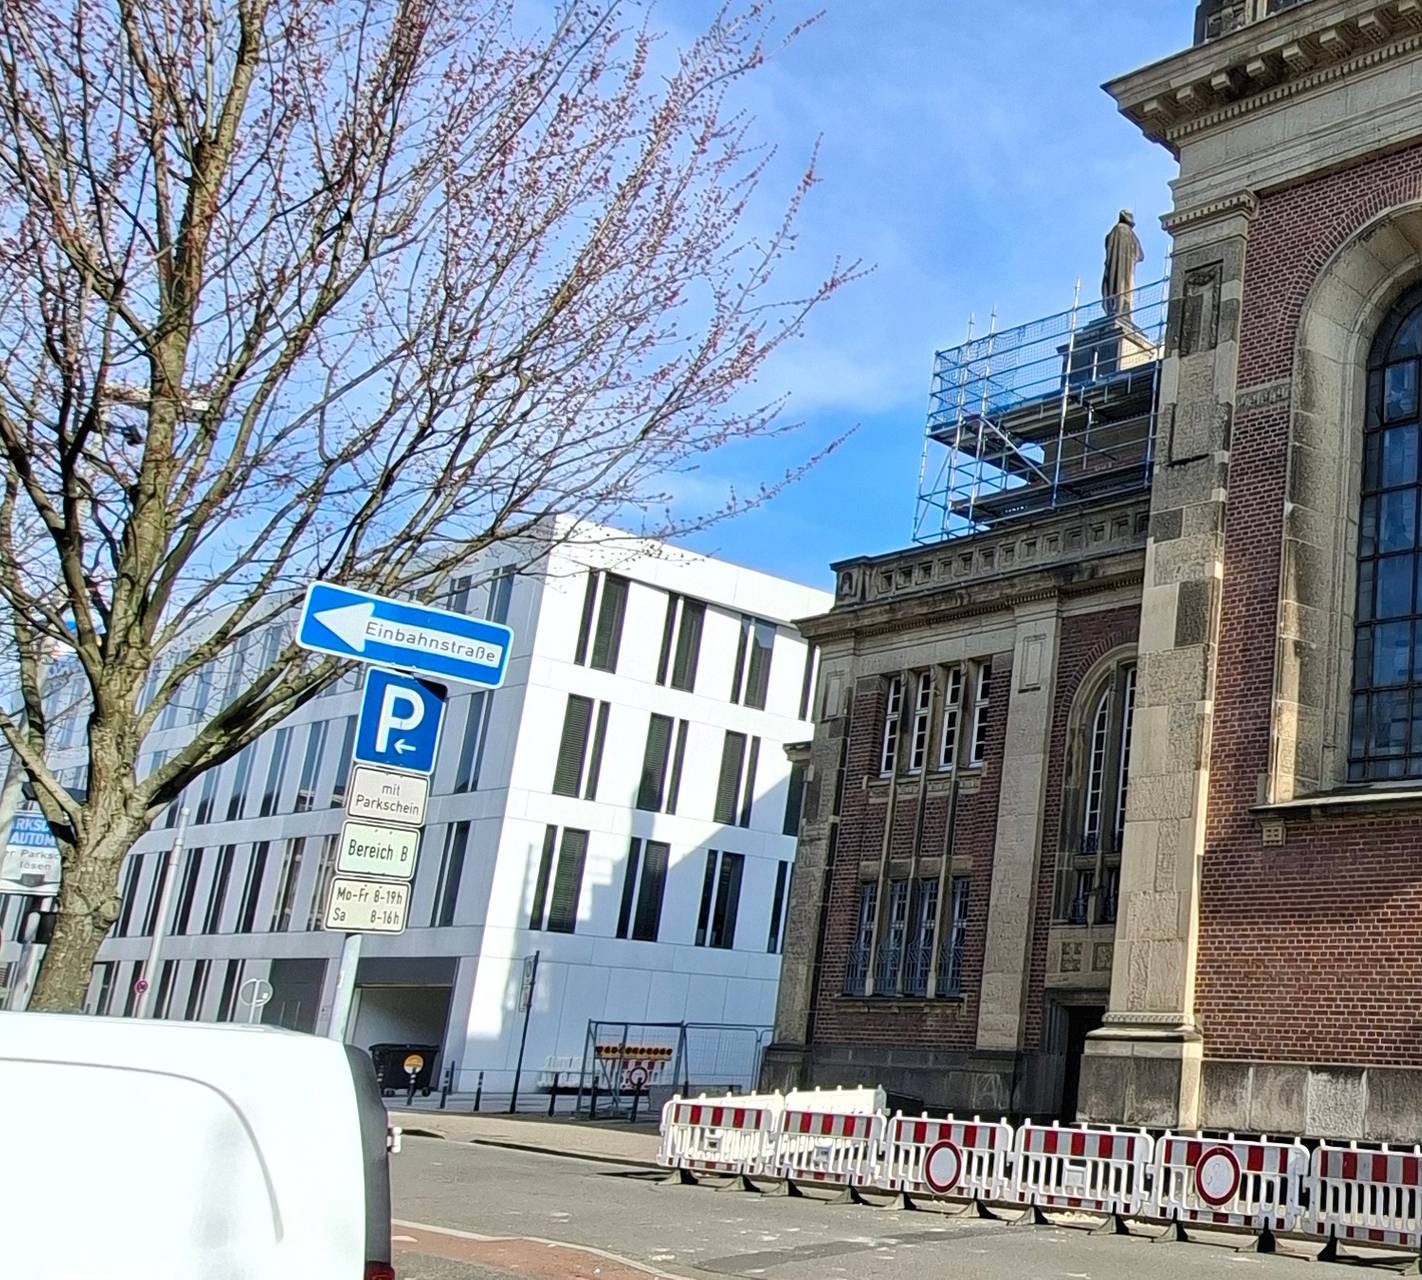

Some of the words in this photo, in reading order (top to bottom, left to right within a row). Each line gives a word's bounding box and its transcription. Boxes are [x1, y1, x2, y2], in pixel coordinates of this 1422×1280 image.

[365, 621, 496, 662] Einbahnstraße
[375, 683, 425, 753] P
[381, 783, 401, 797] mit
[355, 795, 419, 816] Parkschein
[348, 839, 393, 861] Bereich
[400, 845, 409, 862] B
[336, 887, 370, 903] Mo-Fr
[373, 889, 403, 905] 8-19h
[332, 908, 346, 922] Sa
[370, 911, 400, 925] 8-16h
